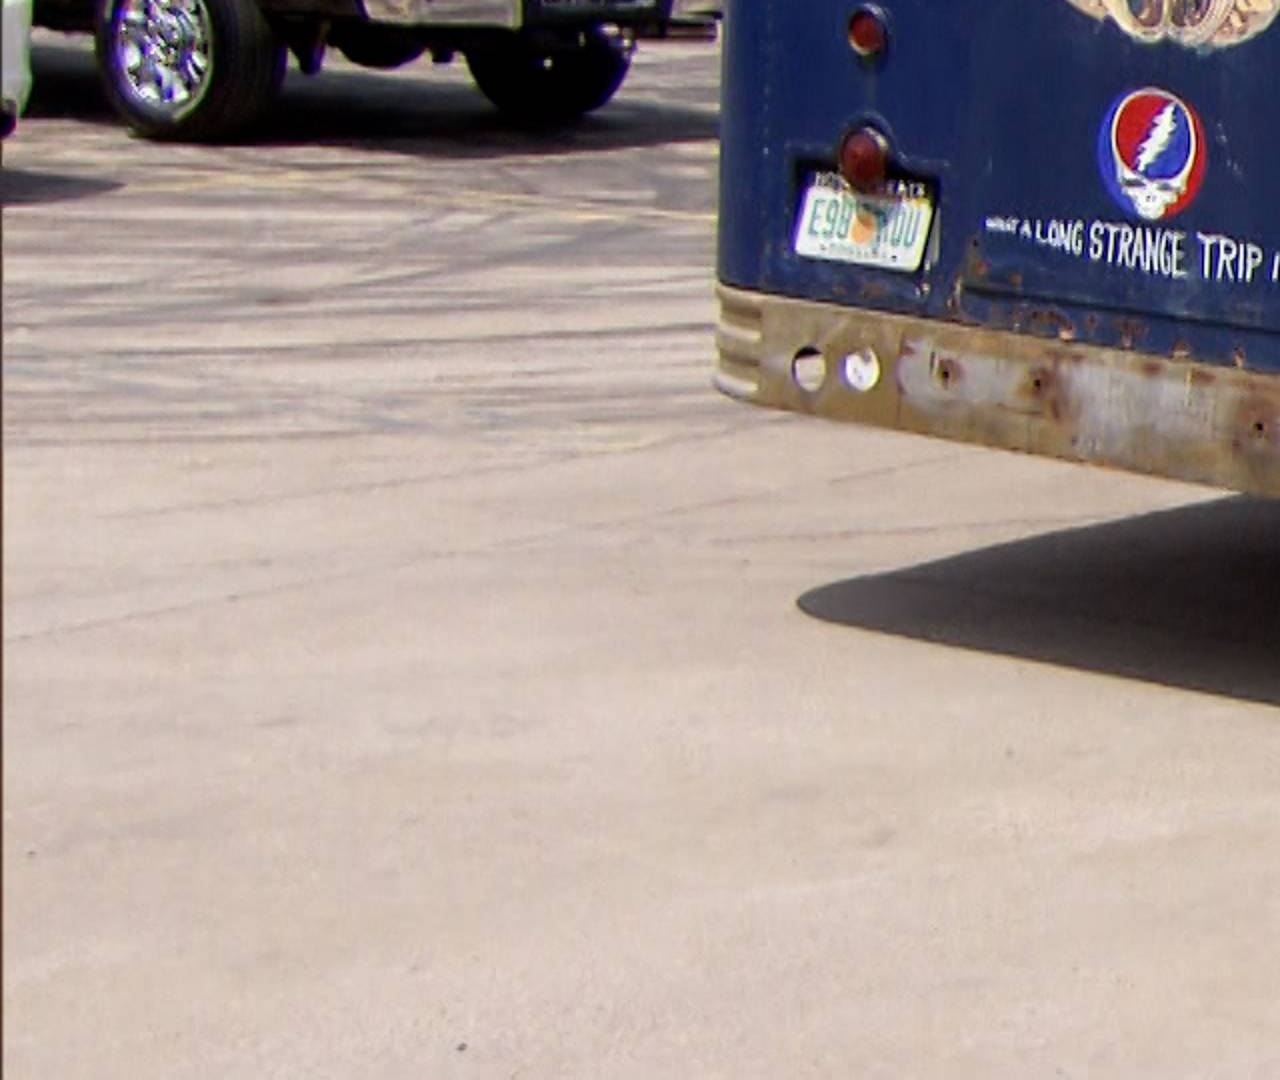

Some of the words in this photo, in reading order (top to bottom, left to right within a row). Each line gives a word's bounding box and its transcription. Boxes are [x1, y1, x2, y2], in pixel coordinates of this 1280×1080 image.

[1020, 220, 1032, 239] A
[1036, 219, 1084, 256] LONG
[1089, 221, 1187, 280] STRANGE
[1197, 232, 1264, 284] TRIP
